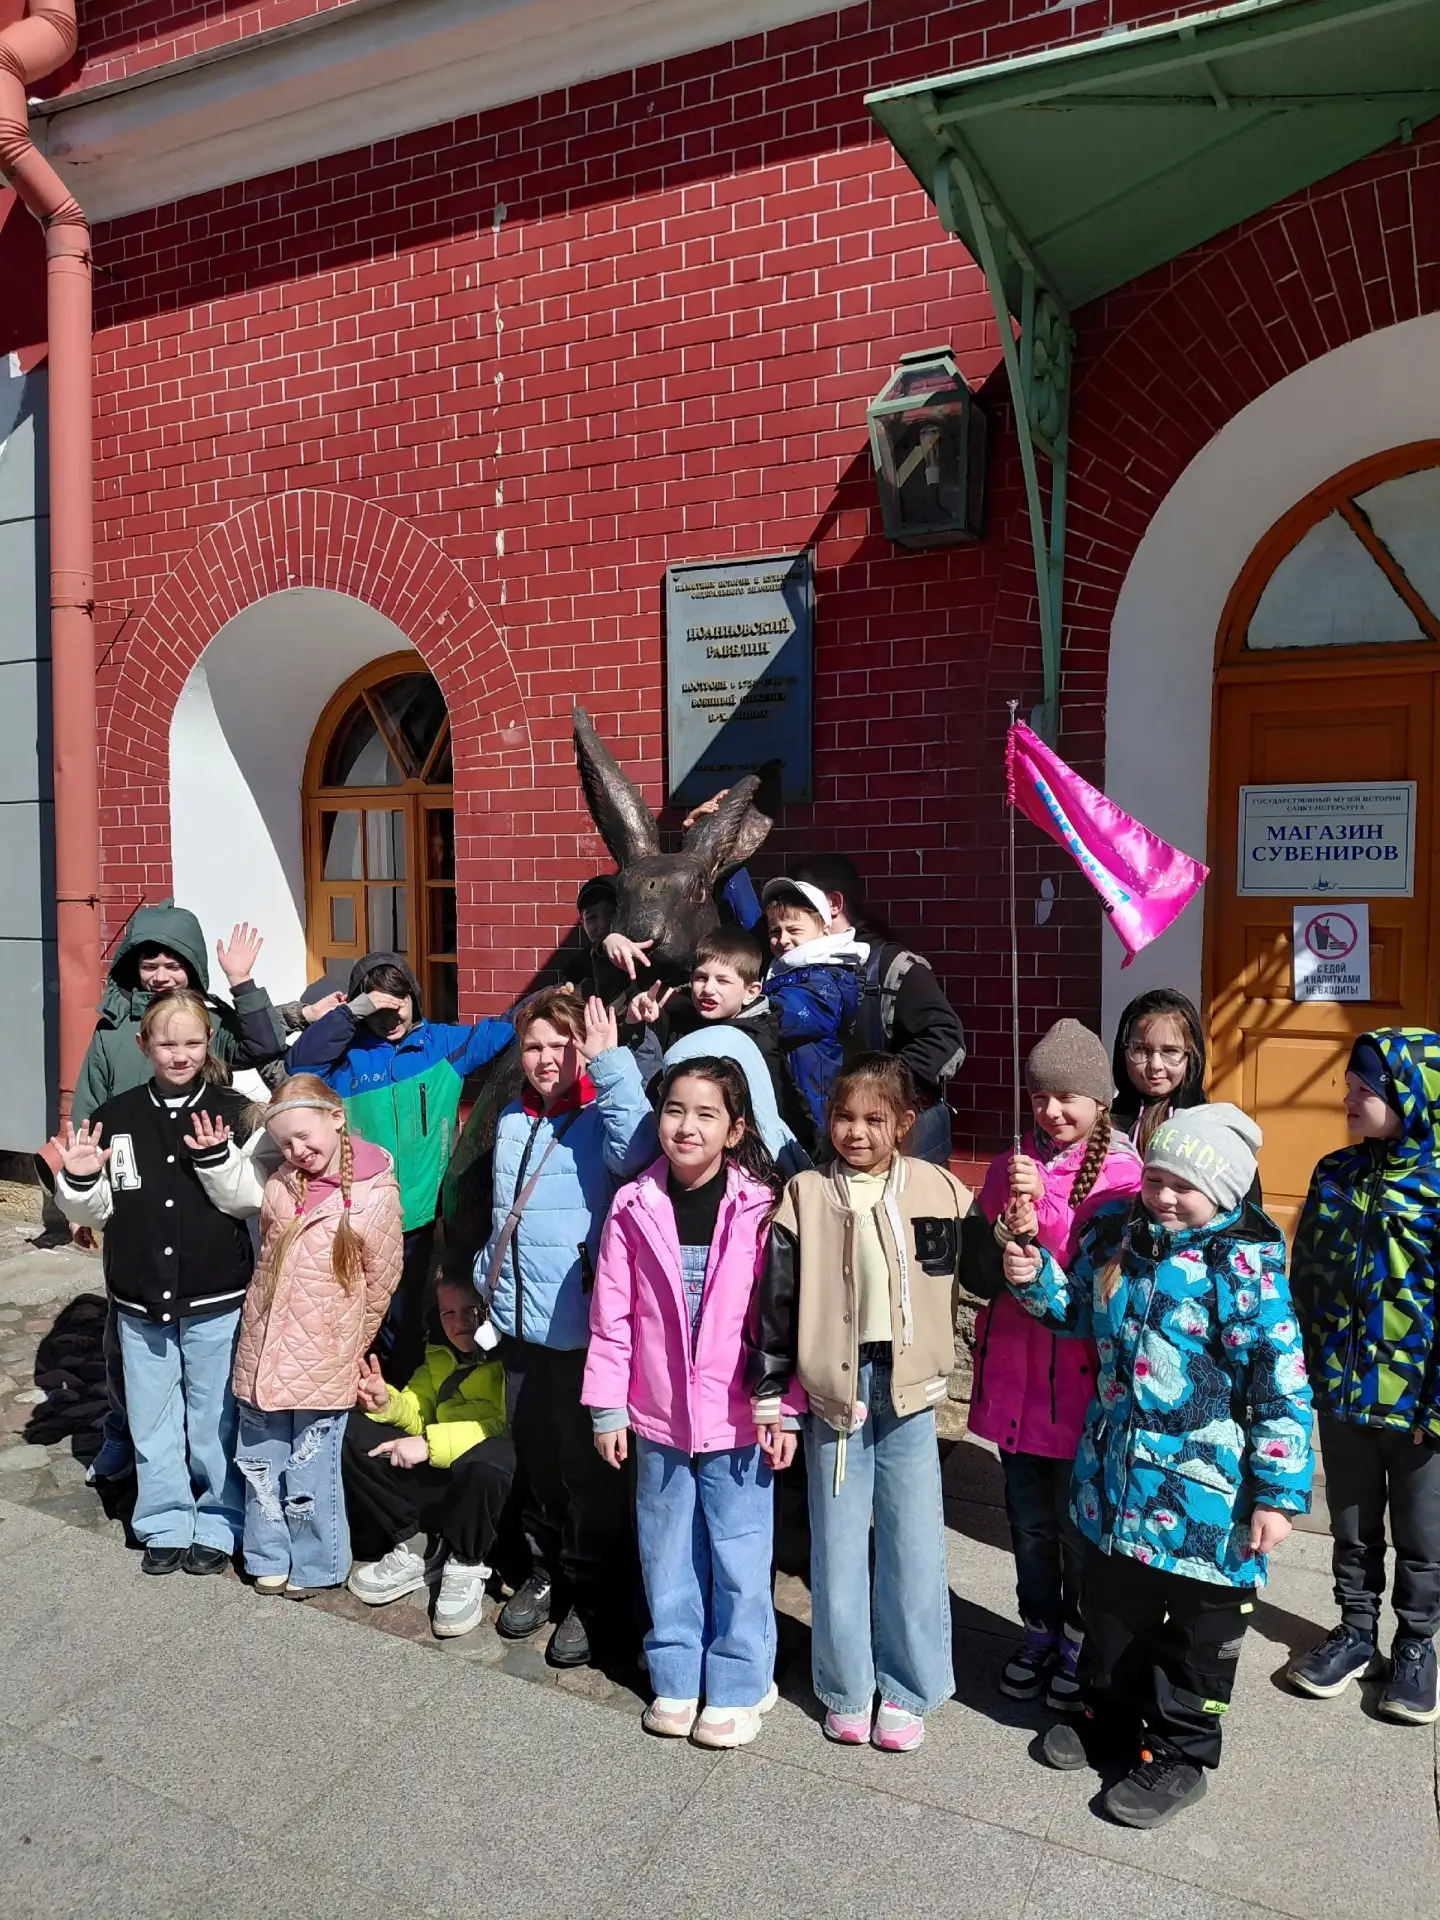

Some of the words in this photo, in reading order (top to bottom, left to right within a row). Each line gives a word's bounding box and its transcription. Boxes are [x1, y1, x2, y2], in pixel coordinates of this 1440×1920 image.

[706, 641, 771, 659] РАВЕЛИН
[1252, 796, 1331, 805] ГОСУДАРСТВЕННЫЙ
[1333, 795, 1361, 803] МУЗЕЙ
[1363, 794, 1401, 802] ИСТОРИИ
[1266, 824, 1384, 841] МАГАЗИН
[1251, 845, 1399, 862] СУВЕНИРОВ
[1317, 964, 1323, 974] С
[1324, 962, 1347, 974] ЕДОЙ
[1303, 975, 1309, 984] И
[1311, 974, 1361, 984] НАПИТКАМИ
[1306, 985, 1317, 995] НЕ
[109, 1133, 142, 1192] A
[911, 1216, 957, 1277] B
